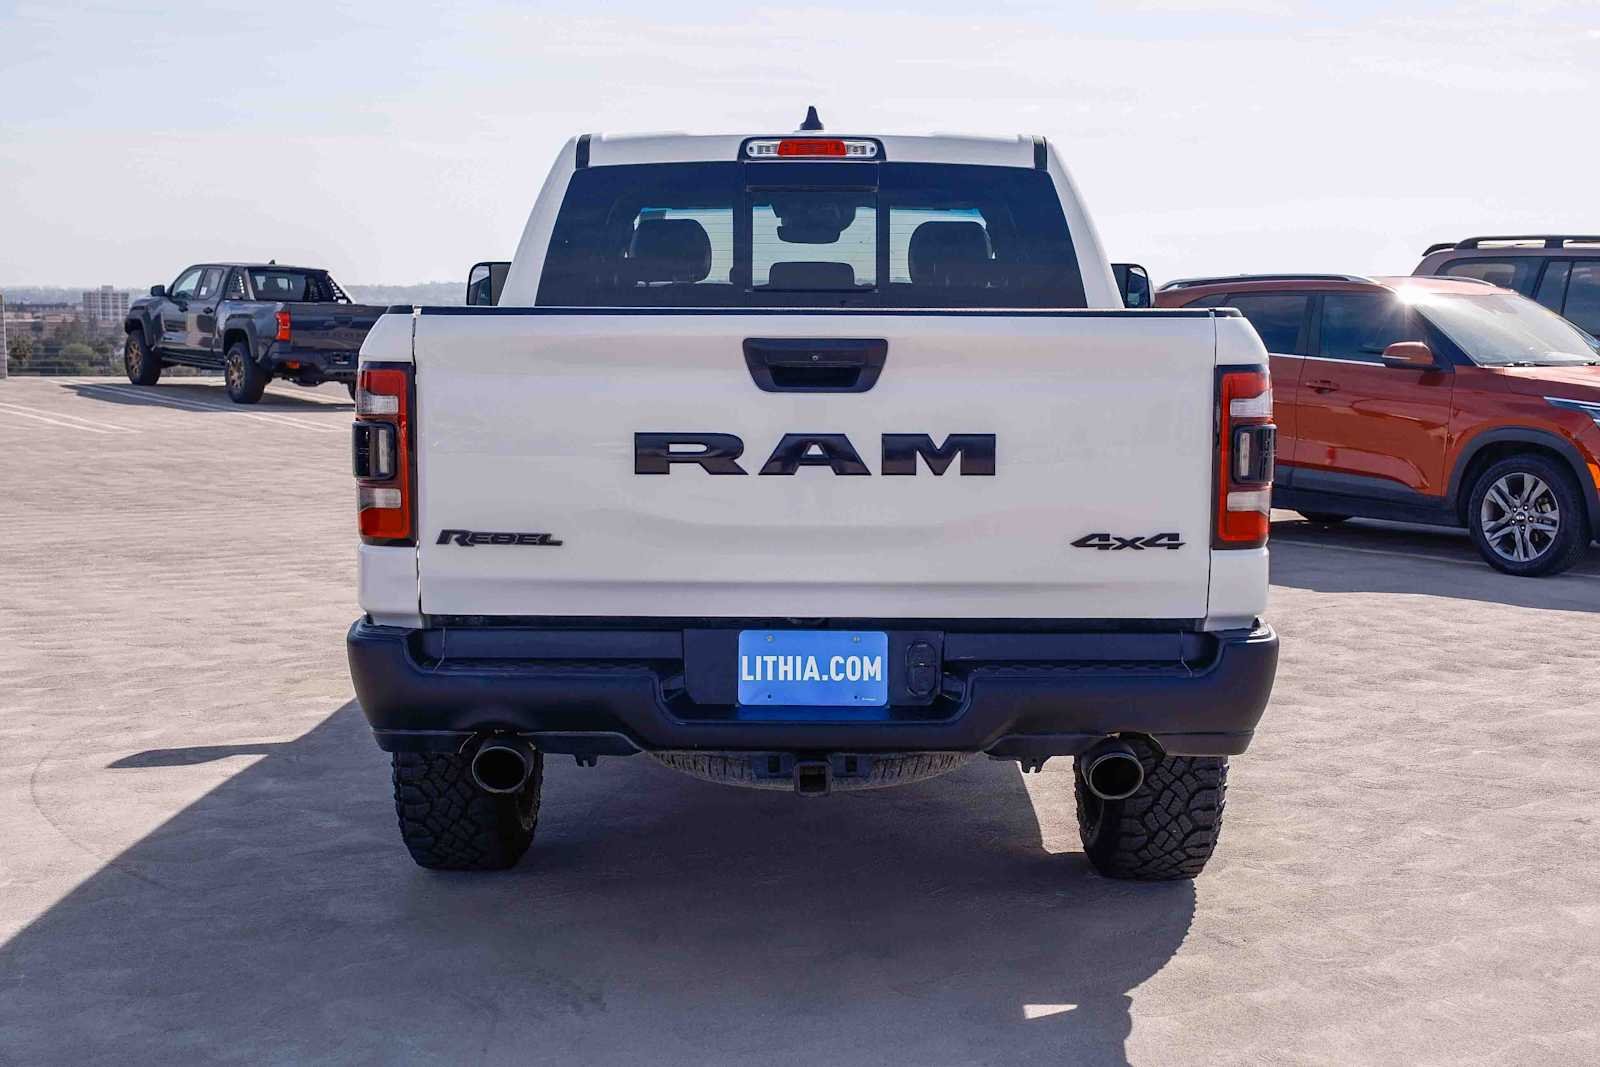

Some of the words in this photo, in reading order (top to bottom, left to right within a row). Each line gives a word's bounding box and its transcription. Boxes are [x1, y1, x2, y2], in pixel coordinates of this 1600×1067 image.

[634, 432, 996, 476] RAM
[436, 529, 563, 547] REBEL
[741, 655, 882, 682] LITHIA.COM
